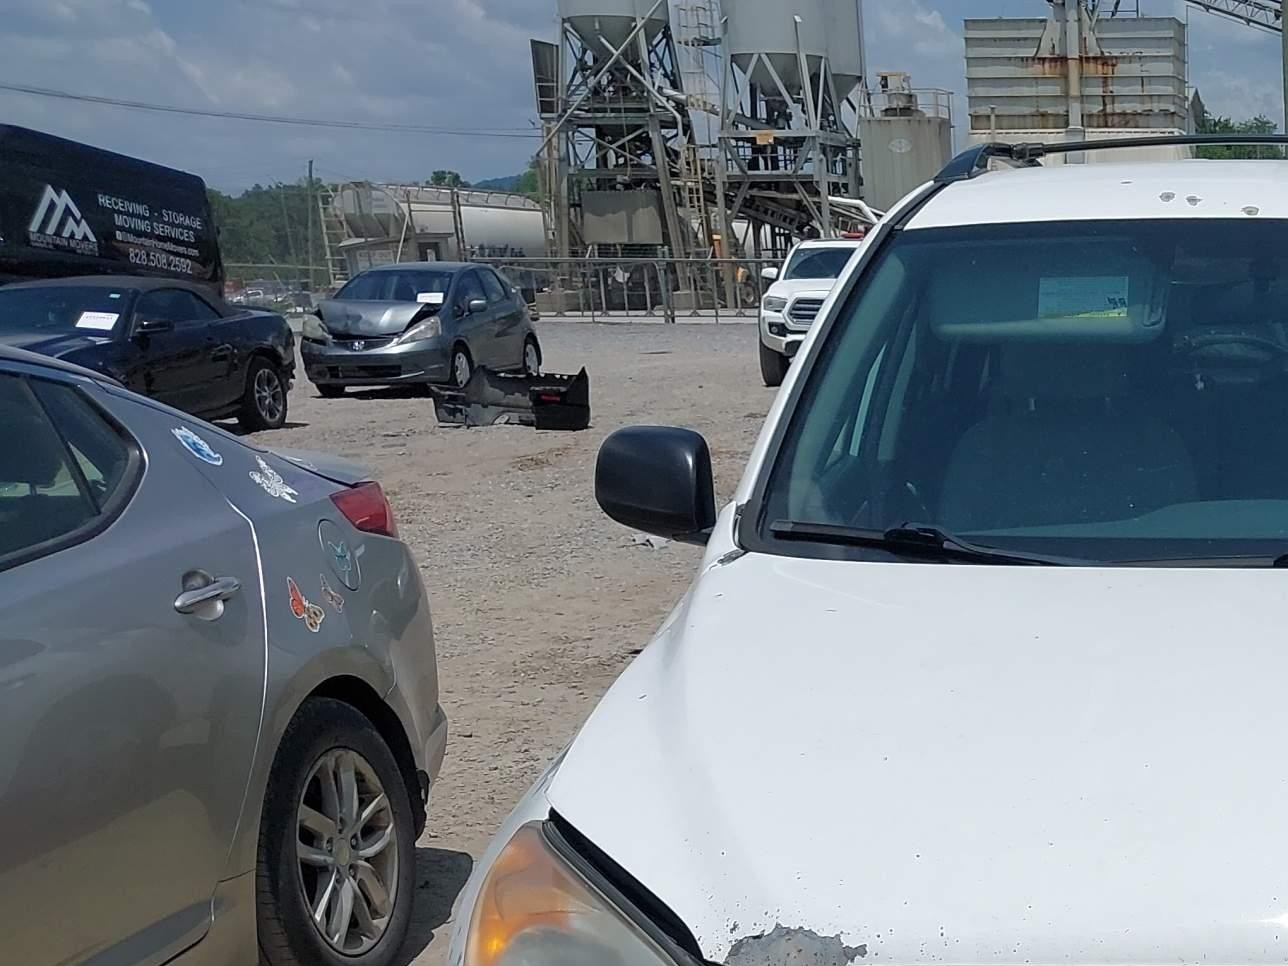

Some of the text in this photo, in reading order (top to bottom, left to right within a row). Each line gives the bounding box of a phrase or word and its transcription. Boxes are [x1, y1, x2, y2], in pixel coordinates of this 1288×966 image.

[97, 193, 149, 217] RECEIVING
[162, 209, 202, 230] STORAGE
[29, 232, 68, 247] MOUNTAIN
[114, 213, 195, 242] MOVING SERVICES
